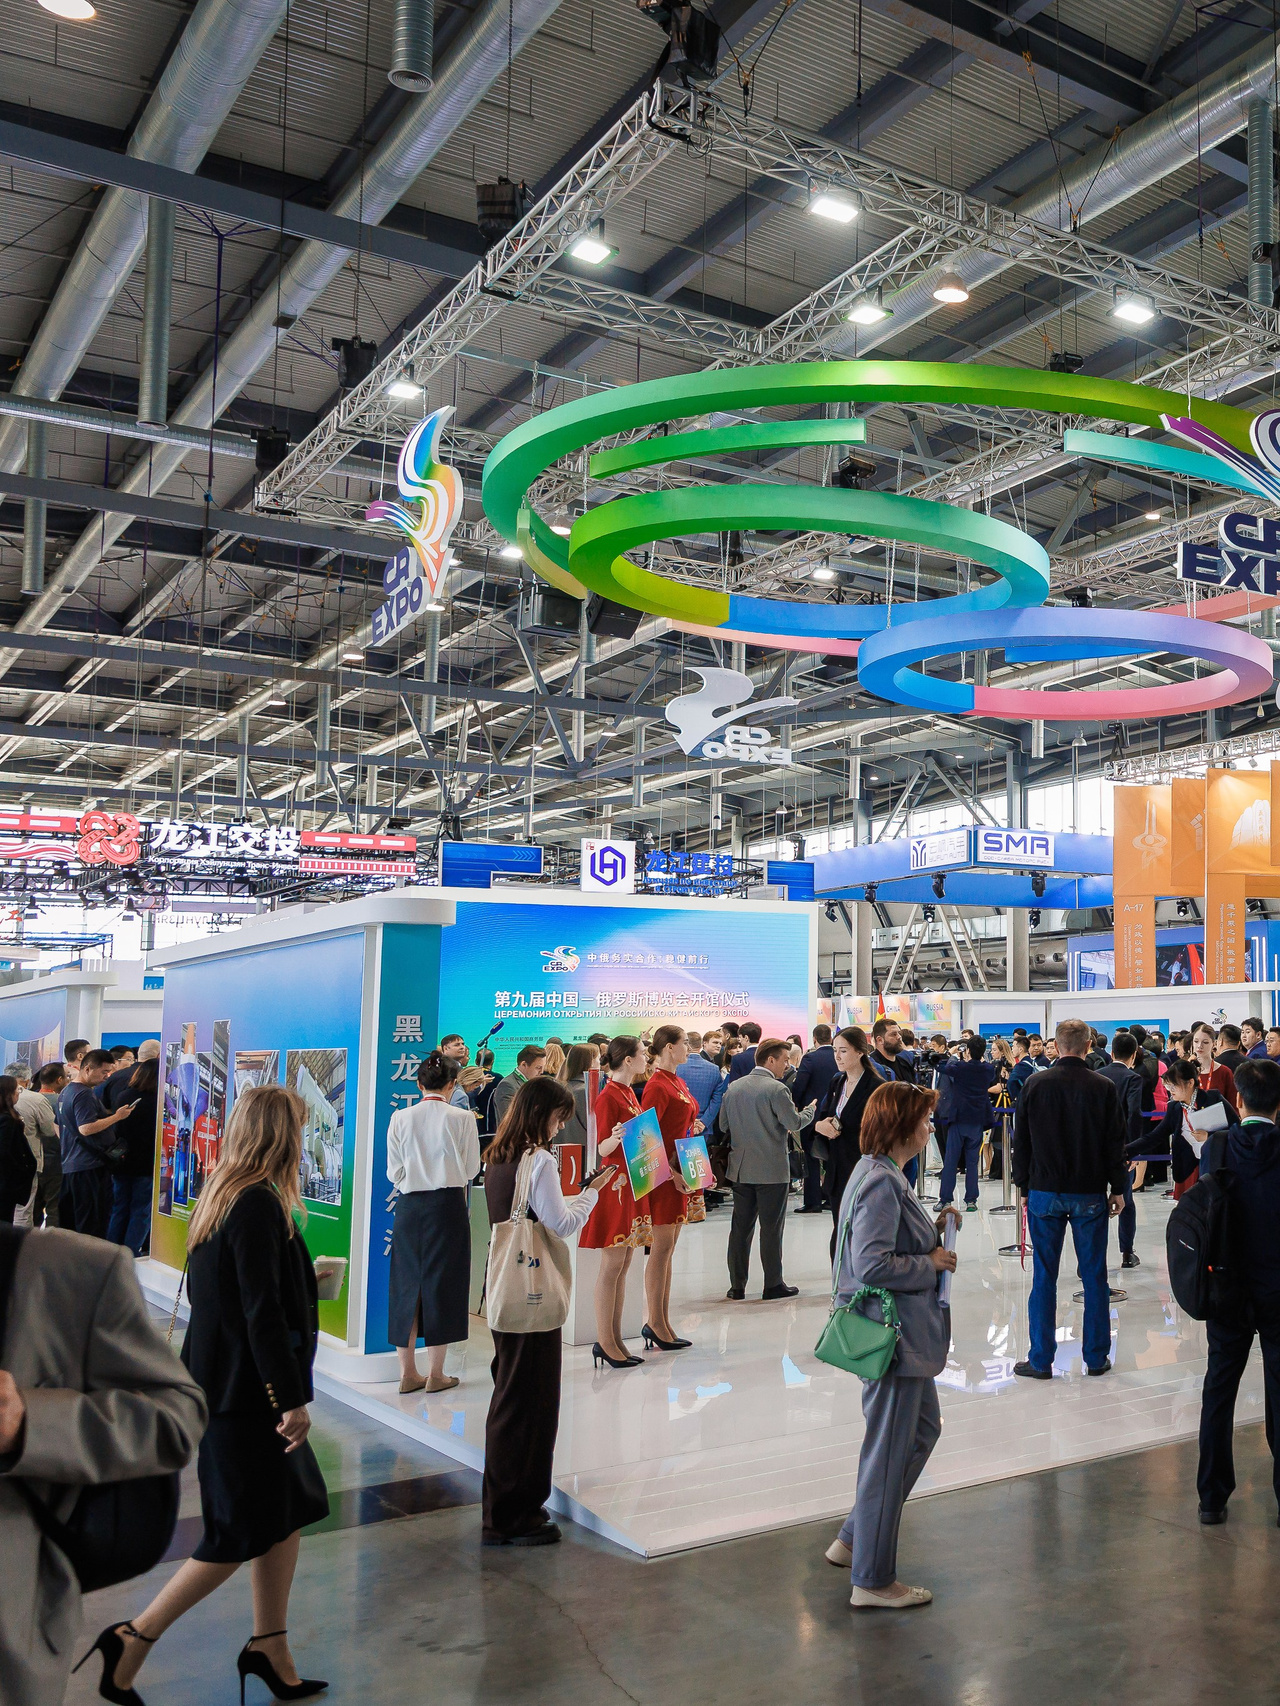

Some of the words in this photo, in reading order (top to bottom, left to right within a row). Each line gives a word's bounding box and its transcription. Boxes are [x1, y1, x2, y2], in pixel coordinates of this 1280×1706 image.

[383, 546, 411, 595] CR
[371, 576, 424, 644] EXPO
[150, 817, 301, 858] 龙江交投
[983, 832, 1050, 856] SMR
[645, 850, 734, 877] 龙江建投
[1123, 903, 1144, 912] A-17
[494, 1010, 552, 1019] ЦЕРЕМОНИЯ
[553, 1009, 602, 1018] ОТКРЫТИЯ
[603, 1009, 611, 1018] IX
[722, 1008, 749, 1018] ЭКСПО
[886, 1005, 901, 1014] CHINA
[926, 1003, 944, 1012] RUSSIA
